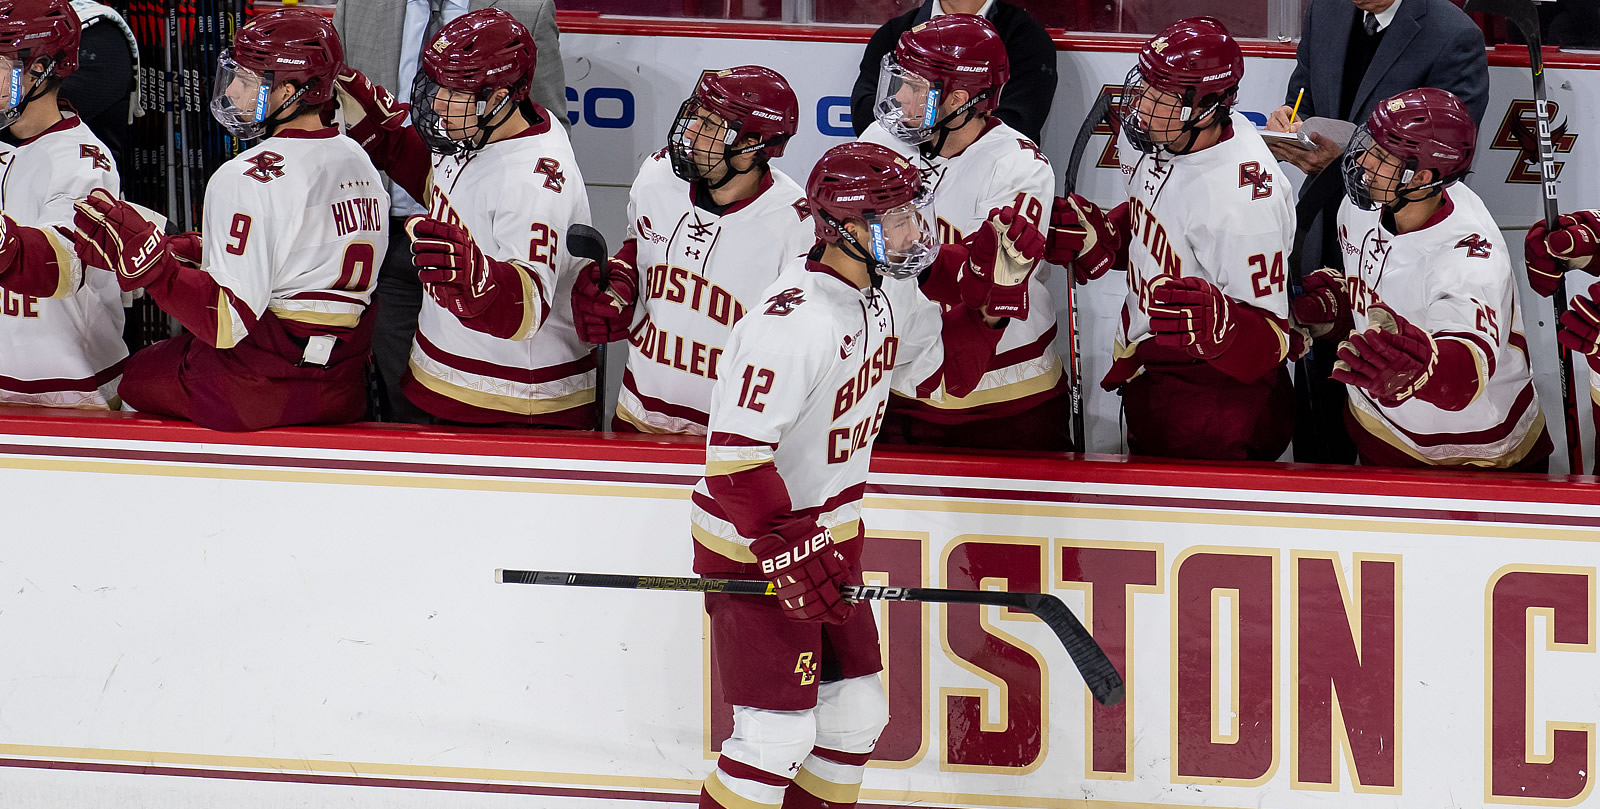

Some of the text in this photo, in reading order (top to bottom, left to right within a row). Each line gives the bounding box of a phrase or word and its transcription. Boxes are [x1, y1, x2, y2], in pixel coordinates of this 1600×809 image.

[276, 57, 306, 66] BAUER
[955, 65, 990, 73] BAUER
[1202, 70, 1232, 82] BAUER
[10, 68, 20, 105] BAUER
[140, 67, 148, 110] BAUER
[149, 67, 157, 110] BAUER
[158, 70, 166, 113] BAUER
[171, 71, 181, 124] NEXUS
[183, 69, 192, 112] BAUER
[192, 69, 201, 112] BAUER
[254, 85, 268, 122] BAUER
[492, 95, 511, 116] BAUER
[751, 109, 784, 122] BAUER
[924, 90, 937, 128] BAUER
[1432, 152, 1460, 160] BAUER
[1536, 99, 1558, 200] BAUER
[331, 198, 381, 237] HUTSKO
[1012, 190, 1043, 231] 19
[225, 212, 252, 256] 9
[528, 221, 559, 275] 22
[872, 223, 887, 261] BAUER
[1090, 256, 1110, 275] BAUER
[1247, 250, 1286, 299] 24
[994, 304, 1019, 312] BAUER
[736, 364, 776, 413] 12
[1560, 359, 1568, 398] BAUER
[1072, 386, 1080, 414] BAUER
[761, 528, 834, 574] BAUER
[703, 531, 1403, 796] OSTON
